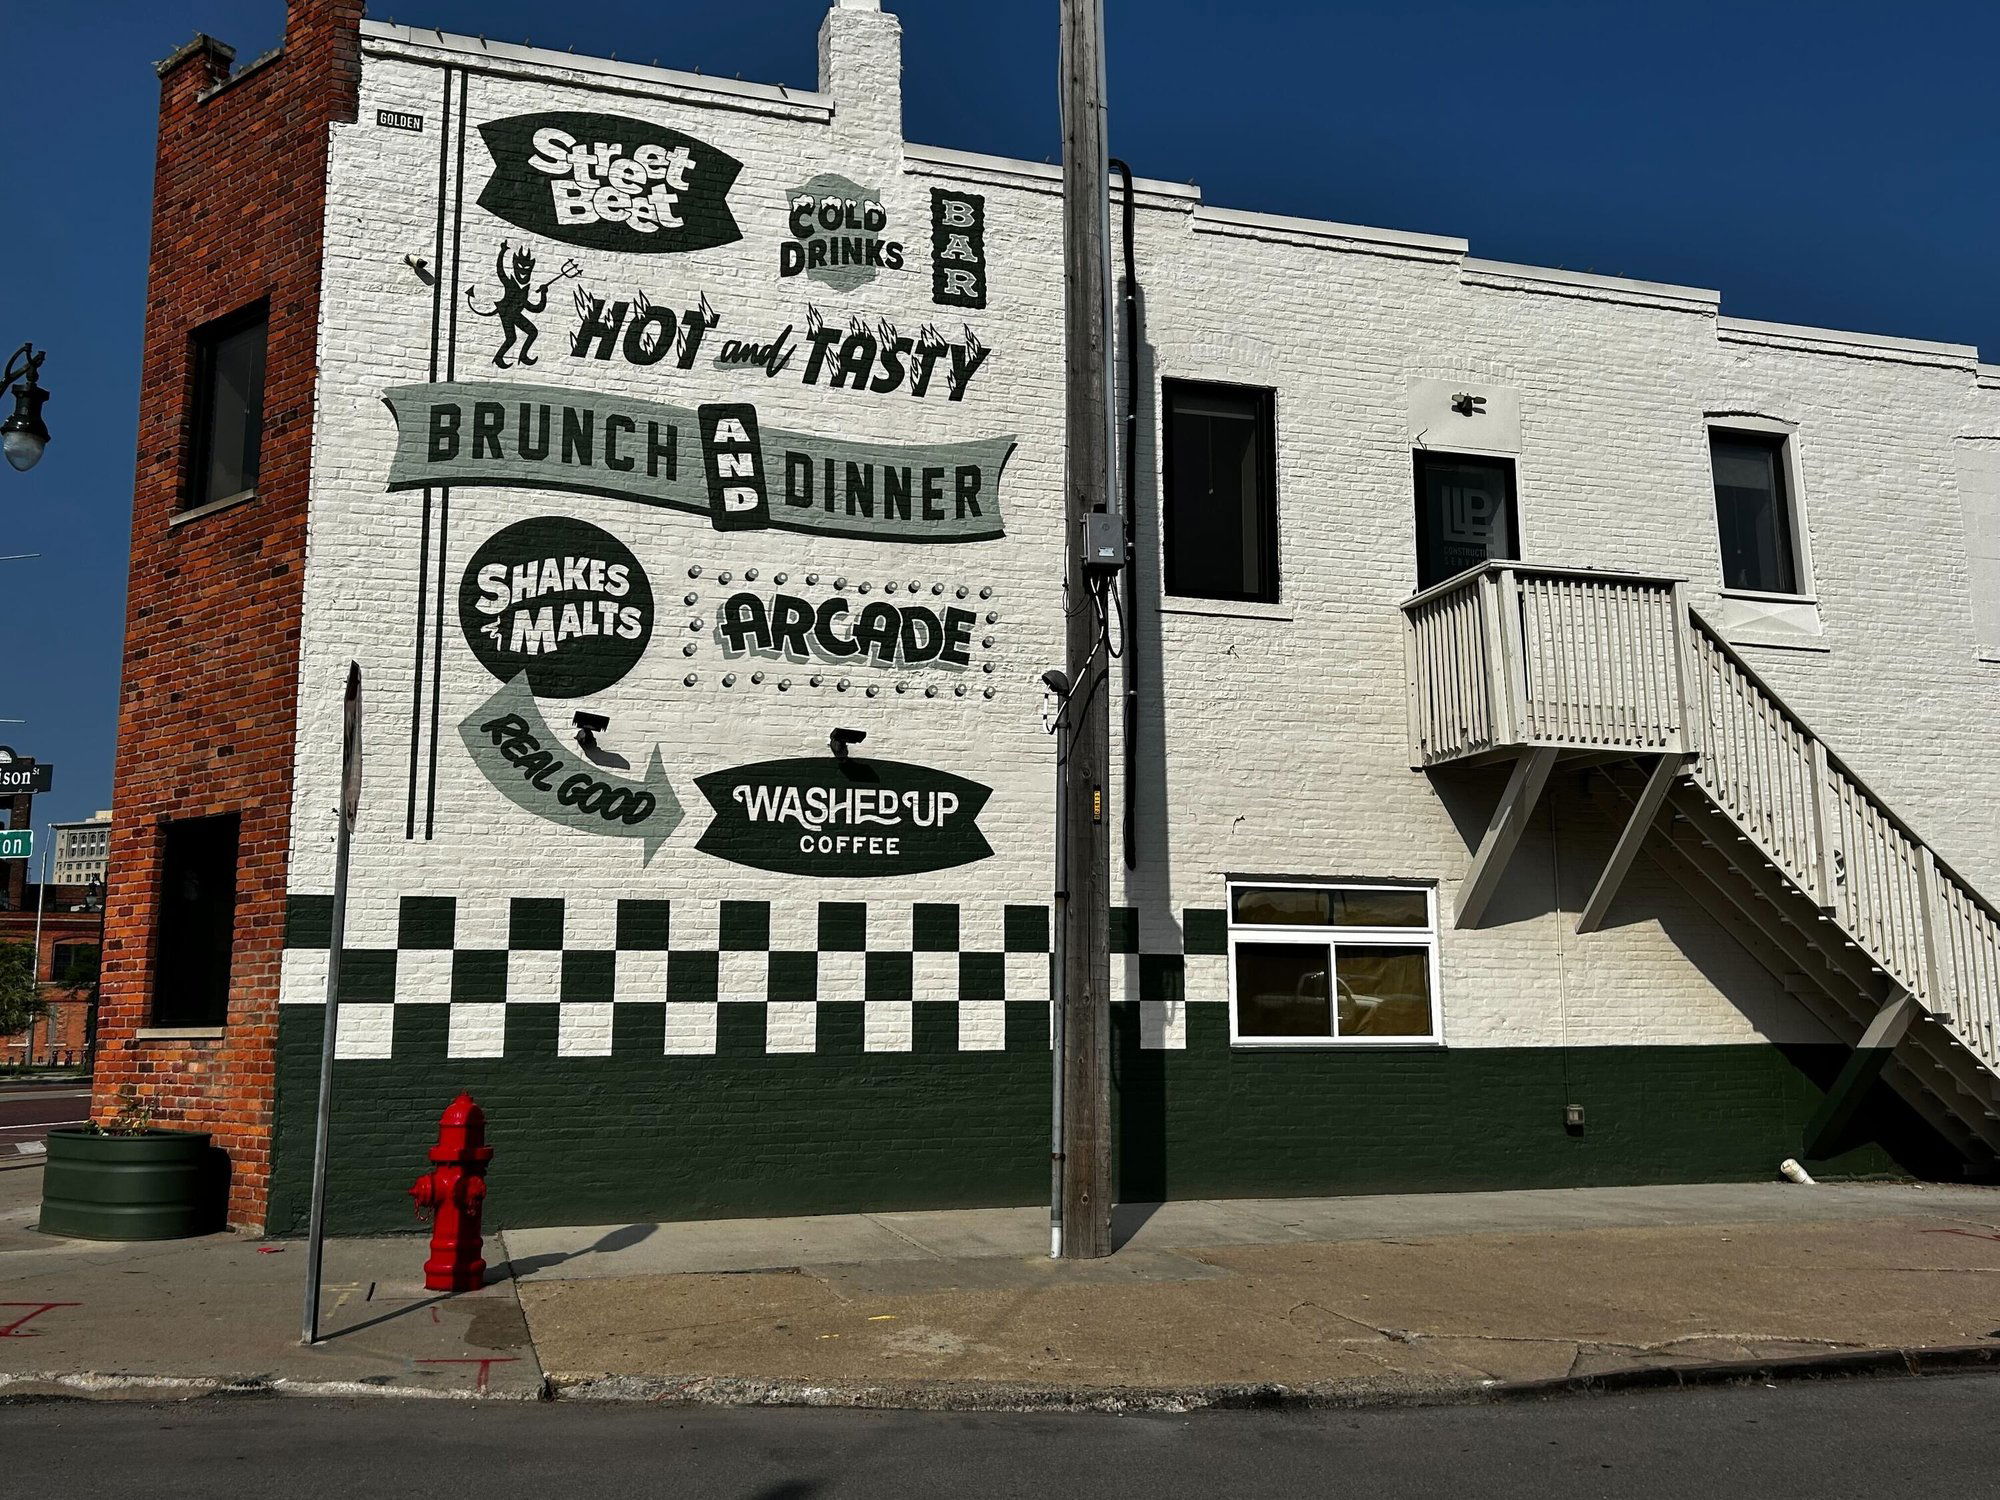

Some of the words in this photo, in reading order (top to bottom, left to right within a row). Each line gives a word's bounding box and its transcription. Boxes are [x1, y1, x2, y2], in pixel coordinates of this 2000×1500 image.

[380, 112, 421, 129] GOLDEN
[528, 127, 697, 195] Street
[550, 184, 684, 233] Beet
[788, 194, 887, 239] COLD
[780, 236, 904, 277] DRINKS
[941, 199, 979, 297] BAR
[570, 284, 721, 370] HOT
[720, 324, 797, 378] and
[802, 302, 992, 402] TASTY
[428, 402, 678, 481] BRUNCH
[713, 418, 759, 512] AND
[785, 450, 983, 521] DINNER
[475, 556, 630, 615] SHAKES
[509, 600, 642, 655] MALTS
[718, 592, 977, 667] ARCADE
[480, 713, 564, 792] REAL
[557, 773, 657, 825] GOOD
[732, 784, 901, 831] WASHED
[901, 790, 959, 827] UP
[2, 839, 22, 854] on
[799, 834, 900, 855] COFFEE
